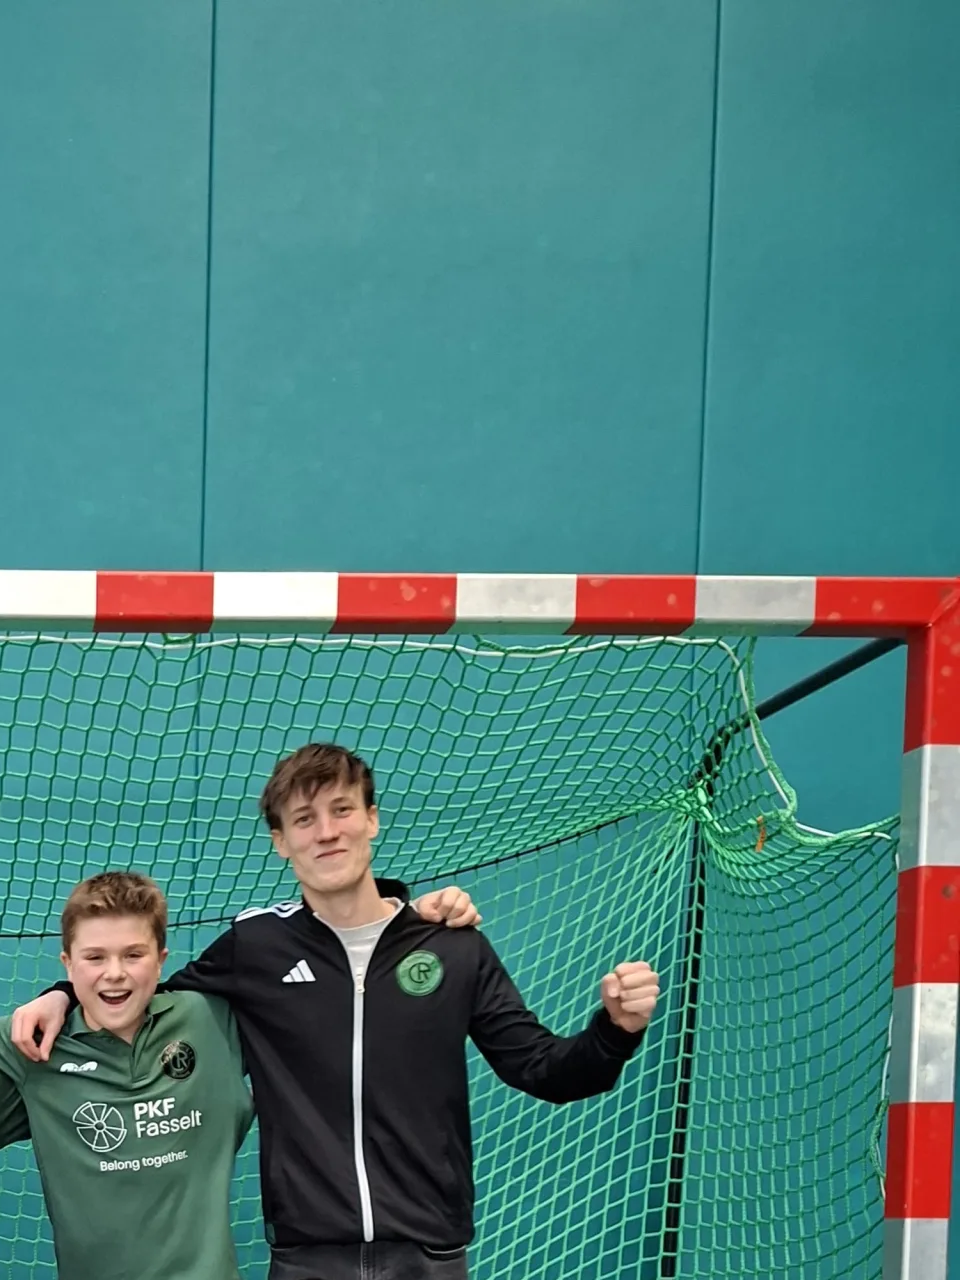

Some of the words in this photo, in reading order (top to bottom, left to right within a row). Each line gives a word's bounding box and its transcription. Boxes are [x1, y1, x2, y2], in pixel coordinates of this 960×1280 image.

[134, 1097, 176, 1121] PKF
[135, 1110, 202, 1138] Fasselt
[99, 1159, 141, 1172] Belong
[141, 1149, 189, 1168] together.
